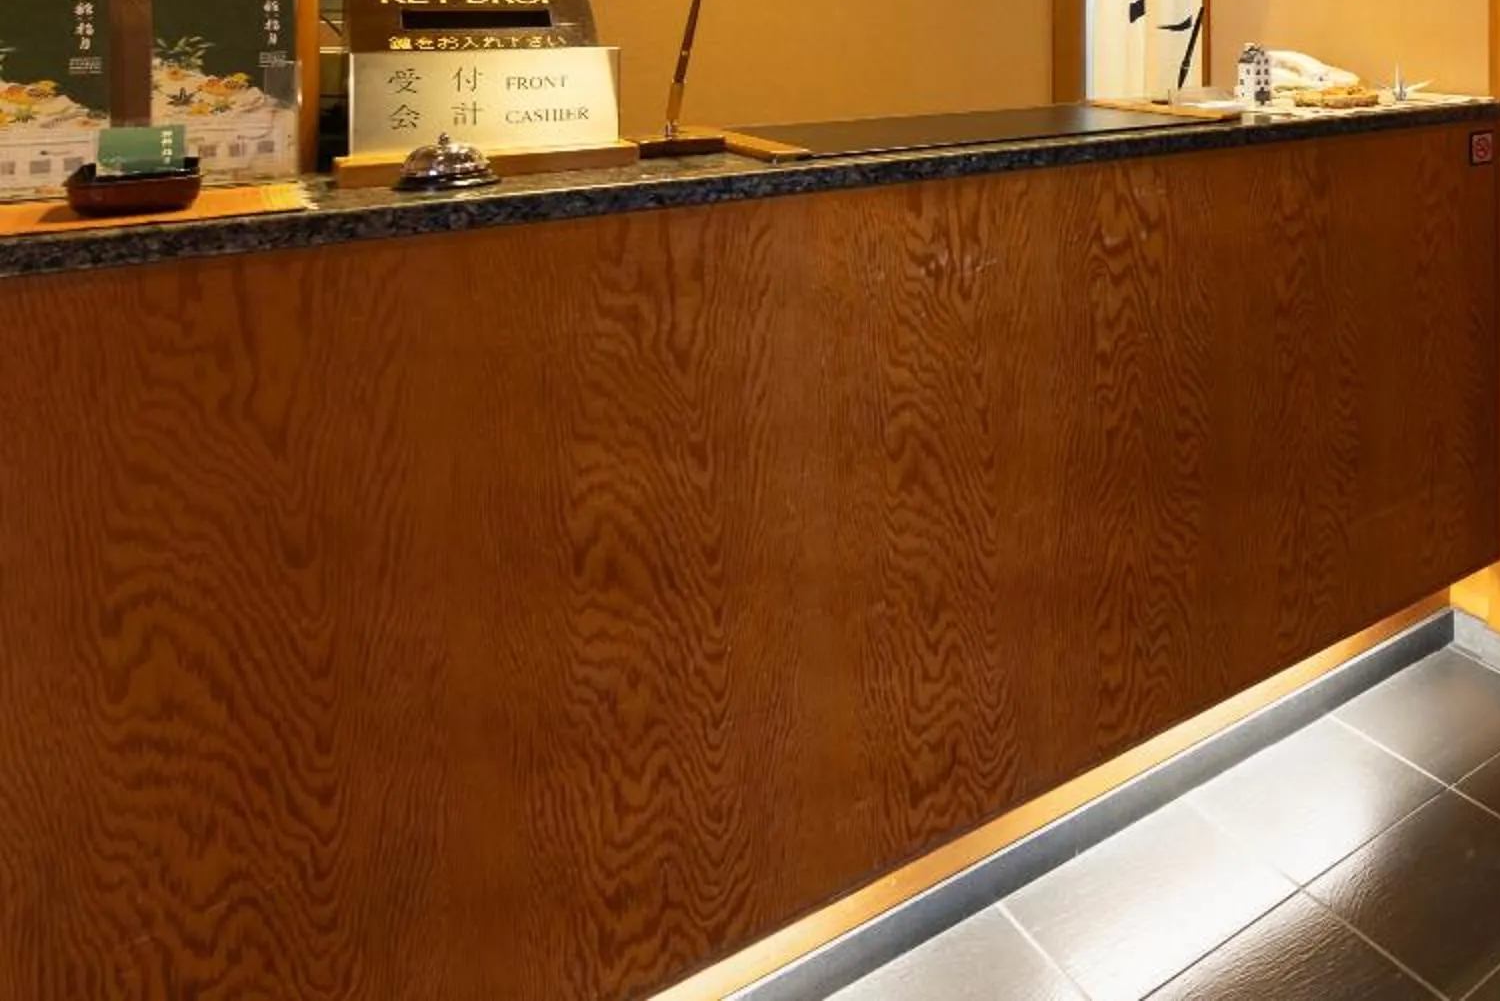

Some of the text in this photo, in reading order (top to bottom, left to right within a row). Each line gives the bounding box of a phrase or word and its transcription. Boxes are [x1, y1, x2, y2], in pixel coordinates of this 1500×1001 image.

[387, 66, 569, 94] 受付 FRONT
[388, 101, 590, 130] 会計 CASHIER
